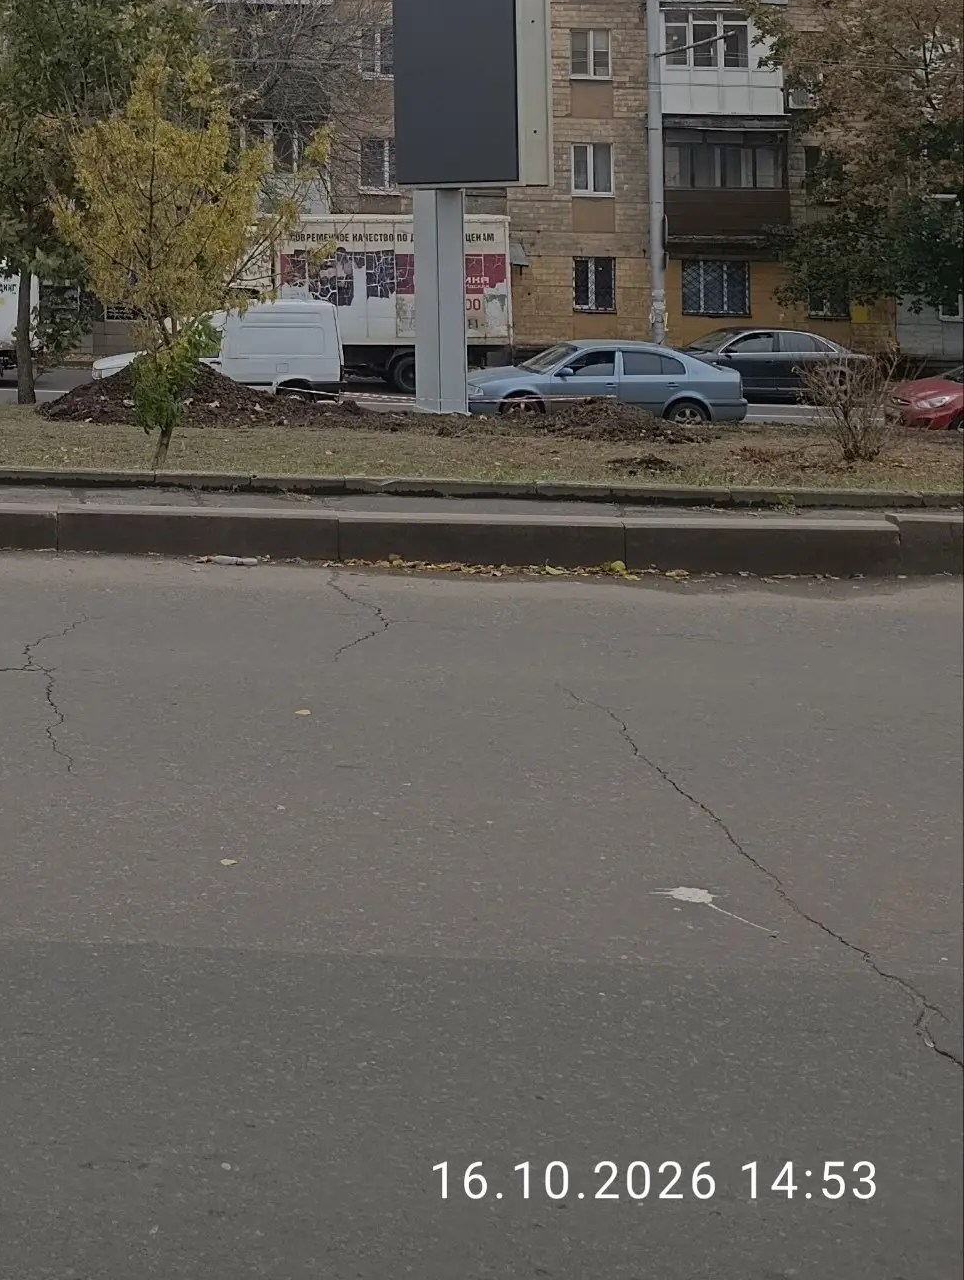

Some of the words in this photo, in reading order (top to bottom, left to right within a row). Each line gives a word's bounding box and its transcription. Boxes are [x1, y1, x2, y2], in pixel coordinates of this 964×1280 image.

[352, 233, 394, 242] КАЧЕСТВО
[396, 233, 408, 242] ПО
[465, 233, 495, 243] ЦЕНАМ
